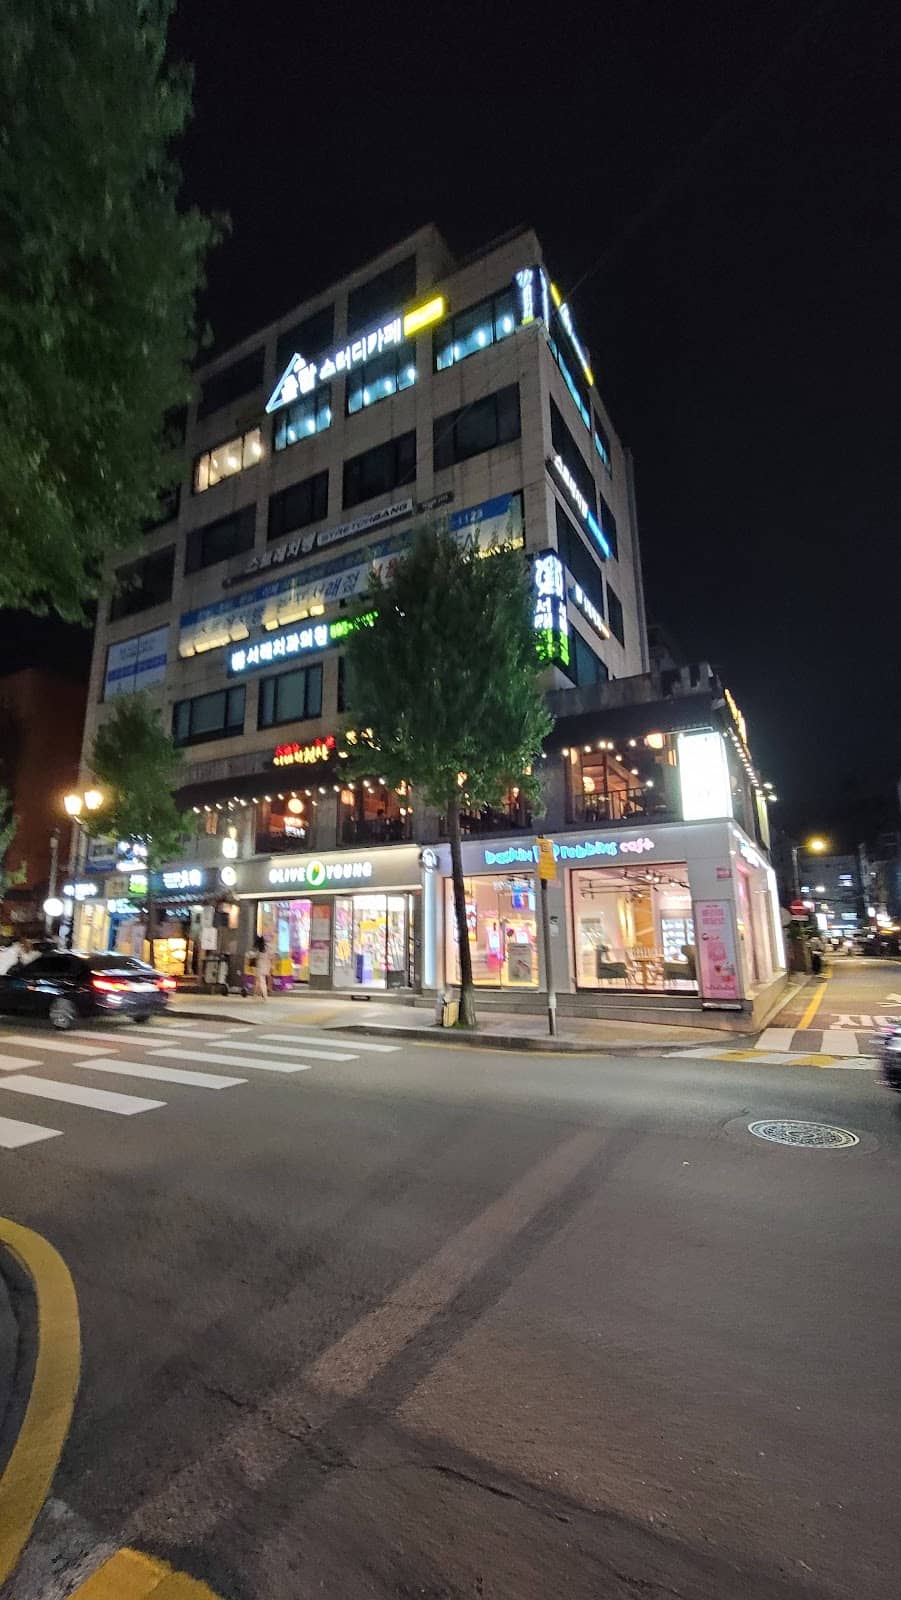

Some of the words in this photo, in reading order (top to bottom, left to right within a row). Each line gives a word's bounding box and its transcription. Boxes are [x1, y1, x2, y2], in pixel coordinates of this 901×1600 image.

[319, 317, 401, 380] 스터디카페
[560, 841, 618, 859] robbins
[268, 866, 306, 884] OLIVE
[326, 861, 373, 880] YOUNG
